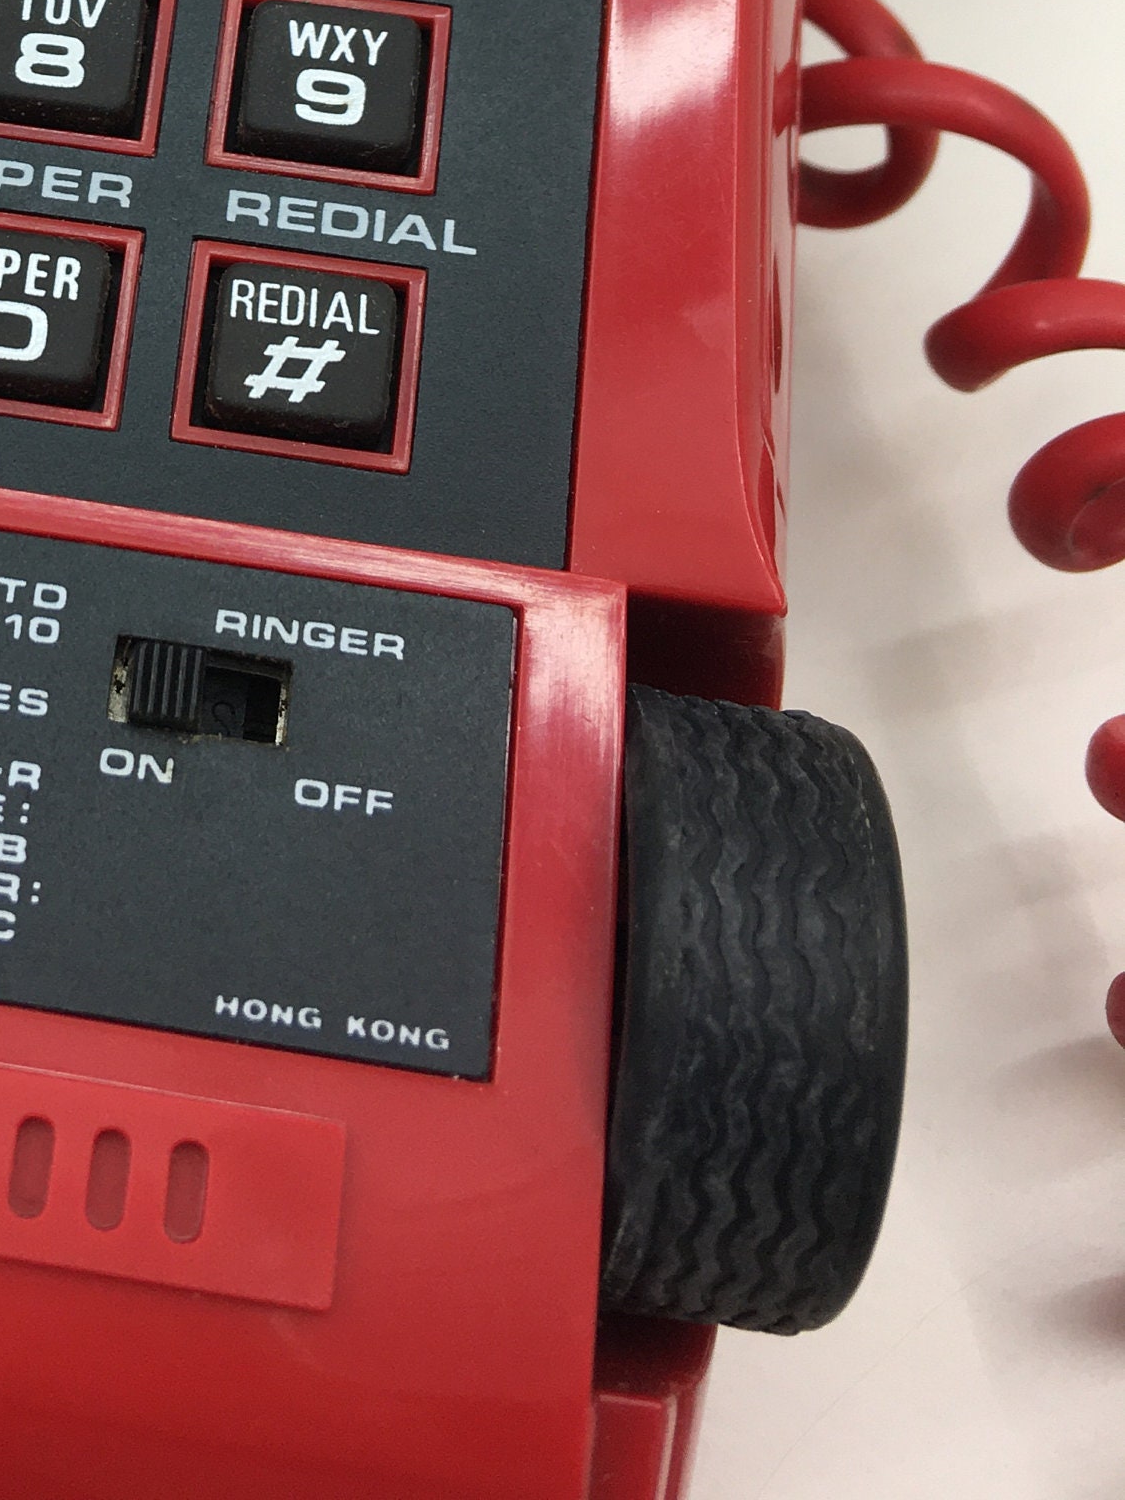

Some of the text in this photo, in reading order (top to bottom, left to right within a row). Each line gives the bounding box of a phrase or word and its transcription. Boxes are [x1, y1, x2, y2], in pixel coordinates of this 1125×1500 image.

[14, 32, 86, 89] 8
[288, 19, 389, 67] WXY
[294, 68, 367, 126] 9
[226, 189, 477, 256] REDIAL
[229, 278, 380, 336] REDIAL
[214, 609, 405, 661] RINGER
[99, 747, 175, 784] ON
[294, 778, 394, 816] OFF
[215, 994, 450, 1050] HONG KONG
